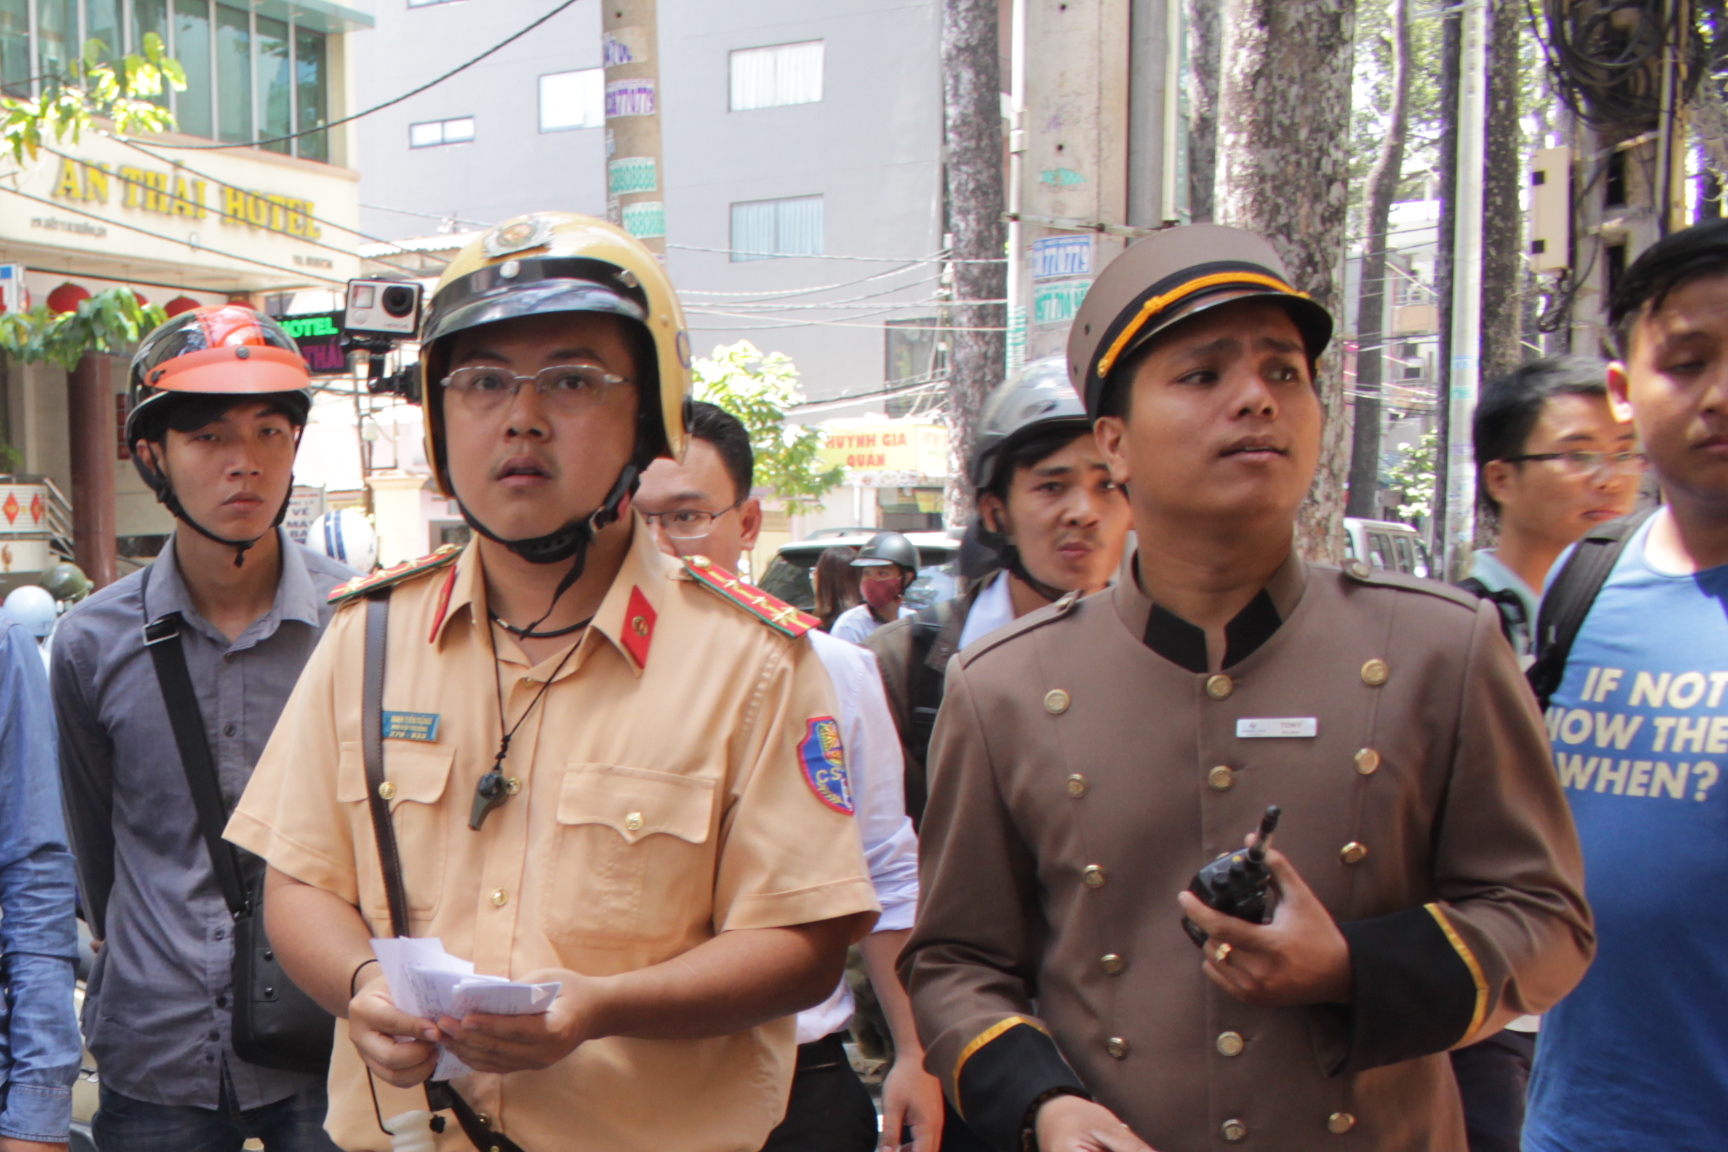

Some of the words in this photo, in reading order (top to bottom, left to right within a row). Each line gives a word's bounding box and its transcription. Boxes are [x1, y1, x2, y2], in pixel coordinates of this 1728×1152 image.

[51, 158, 110, 202] AN
[119, 160, 208, 219] THÁI
[220, 184, 322, 239] HOTEL
[882, 433, 907, 446] GIA
[1580, 667, 1624, 702] IF
[1628, 671, 1728, 709] NOT
[1557, 752, 1720, 802] WHEN?
